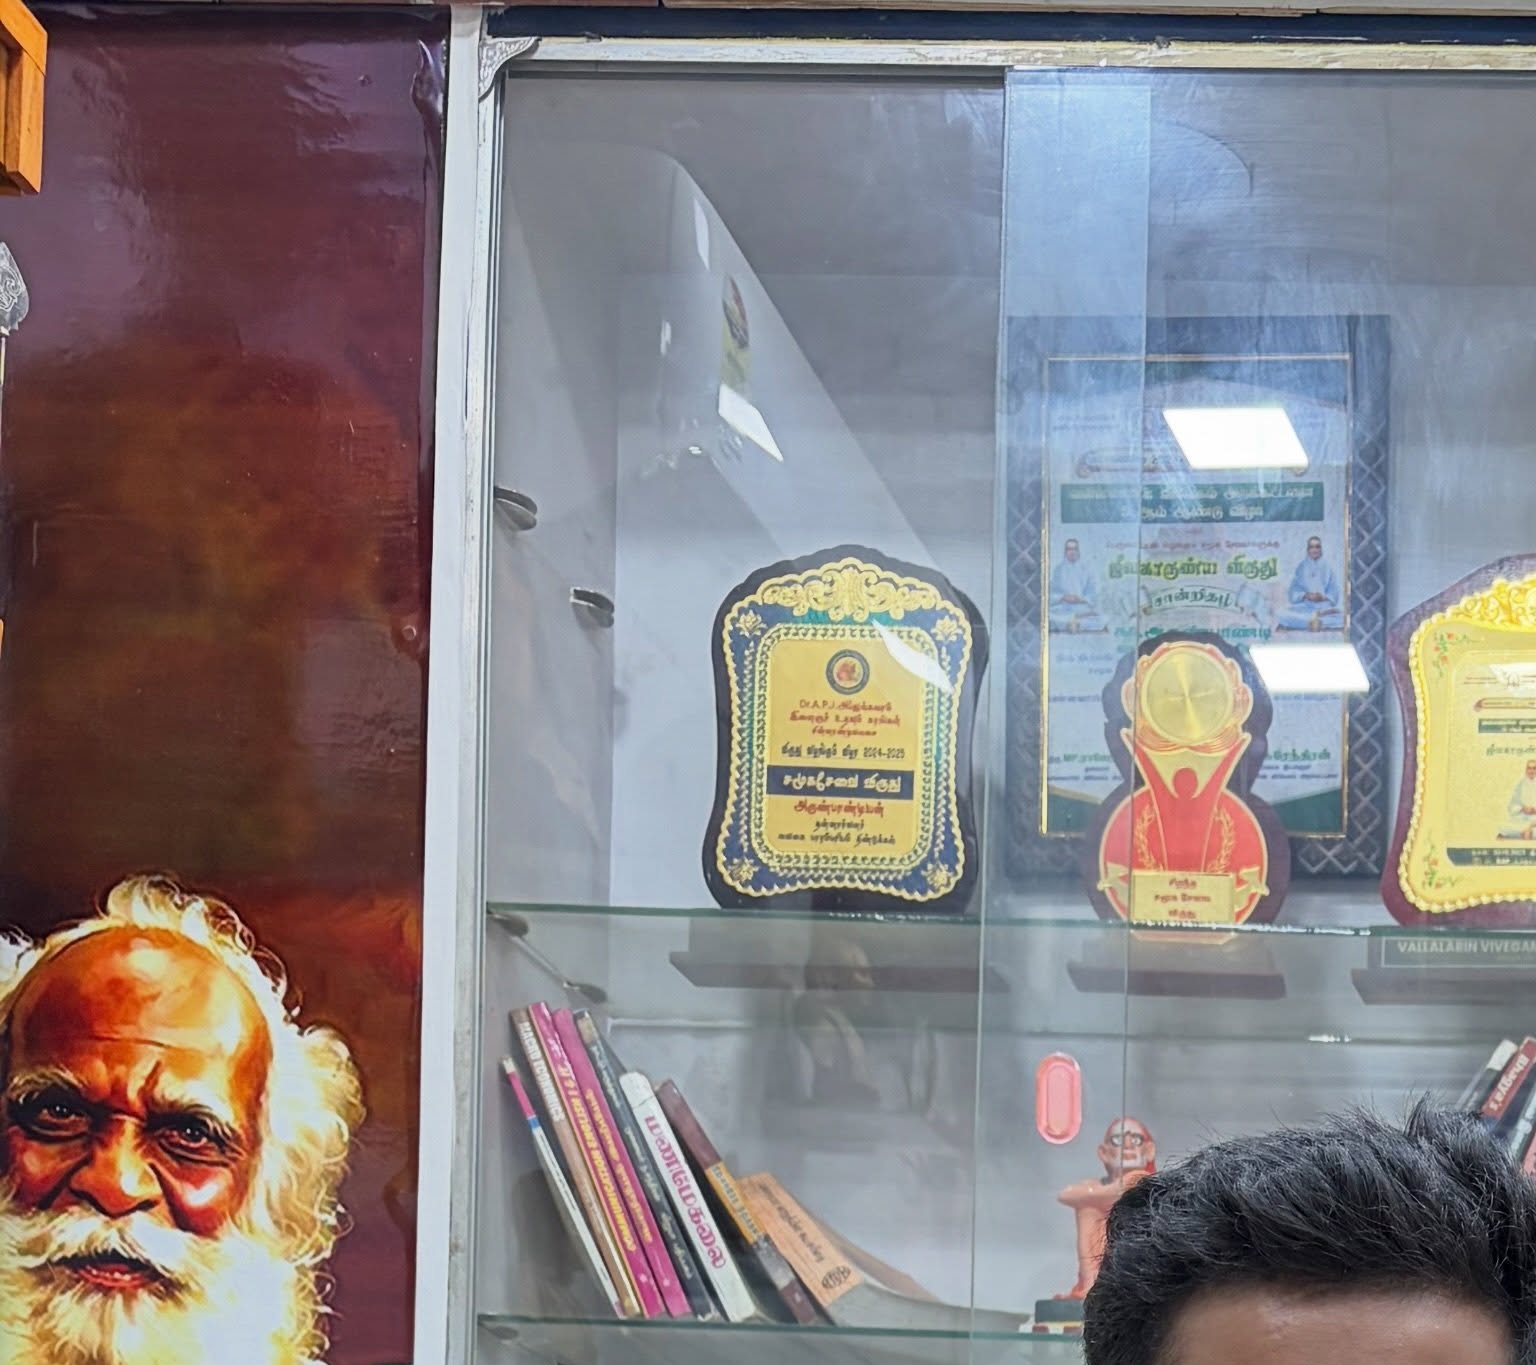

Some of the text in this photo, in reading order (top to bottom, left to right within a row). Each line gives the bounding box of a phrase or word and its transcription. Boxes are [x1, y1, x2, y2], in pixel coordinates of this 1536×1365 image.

[1227, 554, 1279, 580] விருது
[863, 773, 901, 793] விருது
[533, 1059, 565, 1122] ECONOMICS
[1490, 1053, 1531, 1111] Bhagya's
